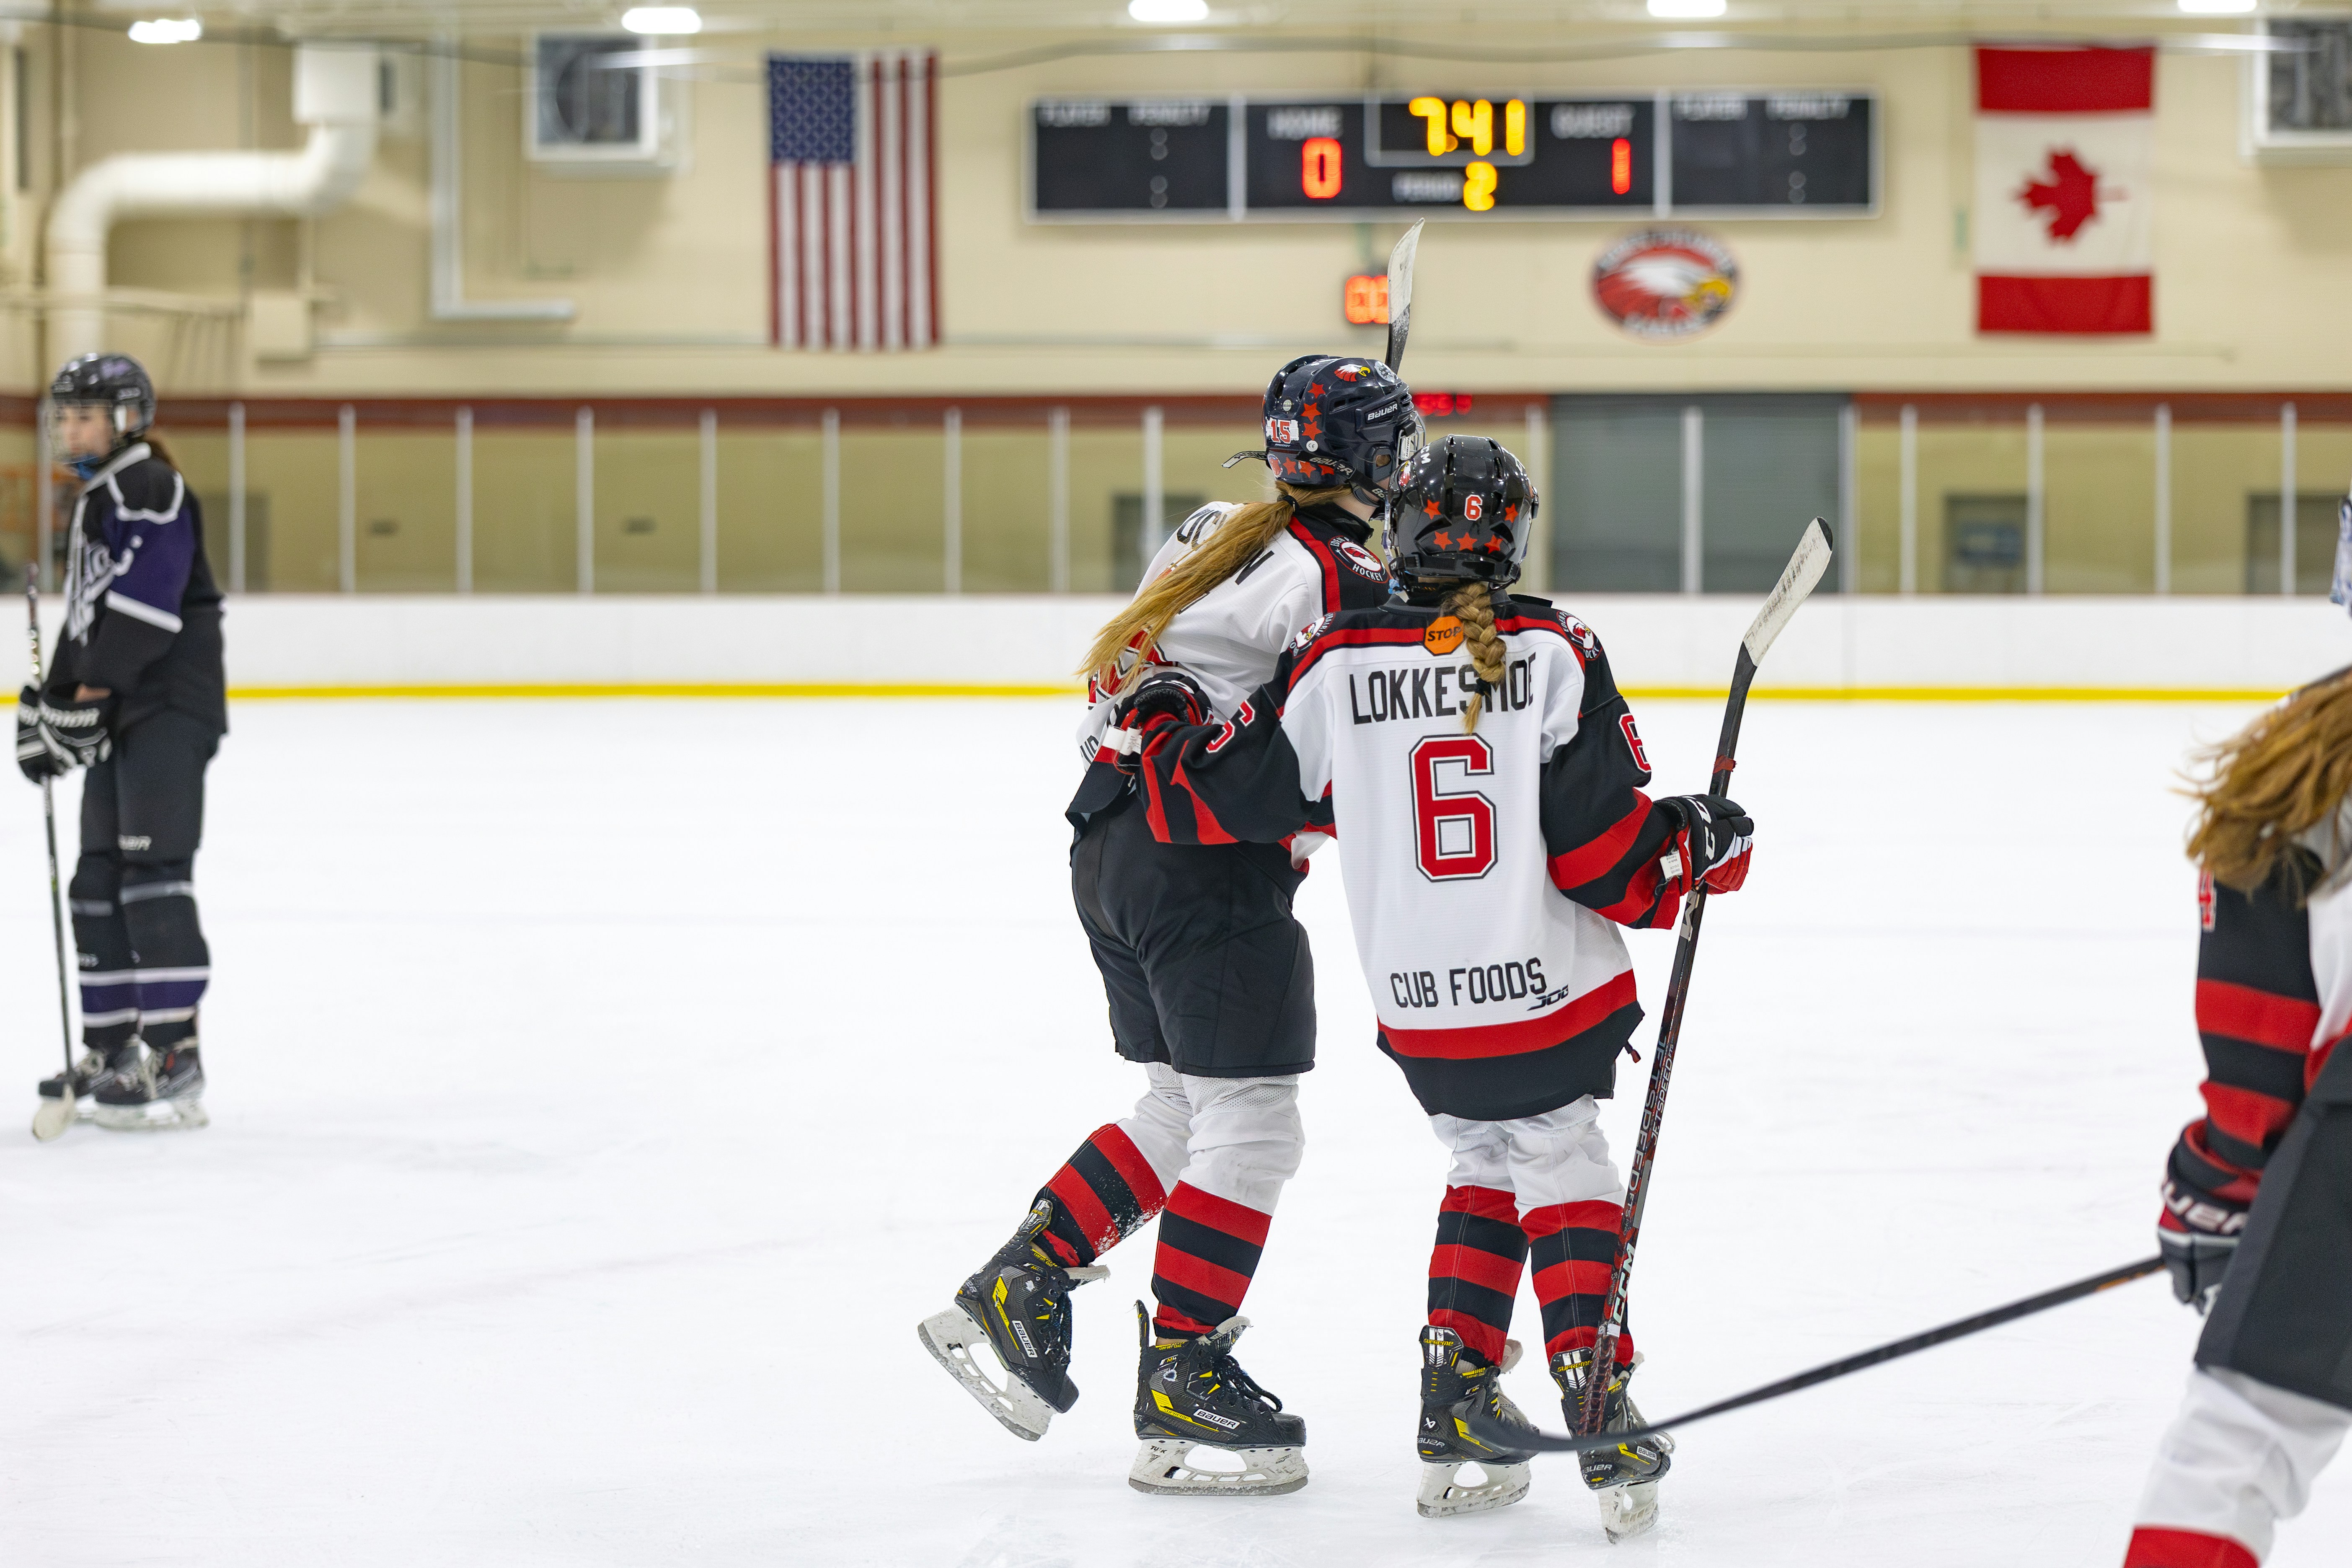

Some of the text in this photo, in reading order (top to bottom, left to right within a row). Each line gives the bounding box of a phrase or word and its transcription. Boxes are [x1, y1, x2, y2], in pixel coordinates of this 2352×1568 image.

[1302, 137, 1341, 198] 0
[1612, 138, 1631, 194] 1
[1463, 161, 1497, 210] 2
[1367, 403, 1398, 421] BAUER
[1270, 419, 1292, 444] 15
[1464, 495, 1482, 520] 6
[1352, 564, 1383, 581] HOCKEY
[1427, 626, 1462, 641] STOP
[1409, 733, 1498, 883] 6
[1390, 957, 1547, 1008] CUB FOODS
[1651, 1058, 1672, 1146] JETSPEED
[1613, 1243, 1636, 1323] CCM
[1015, 1323, 1035, 1356] BAUER
[1163, 1408, 1189, 1420] SUPREME
[1197, 1410, 1236, 1428] BAUER
[1639, 1448, 1656, 1459] BAUER
[1584, 1464, 1613, 1473] AUER
